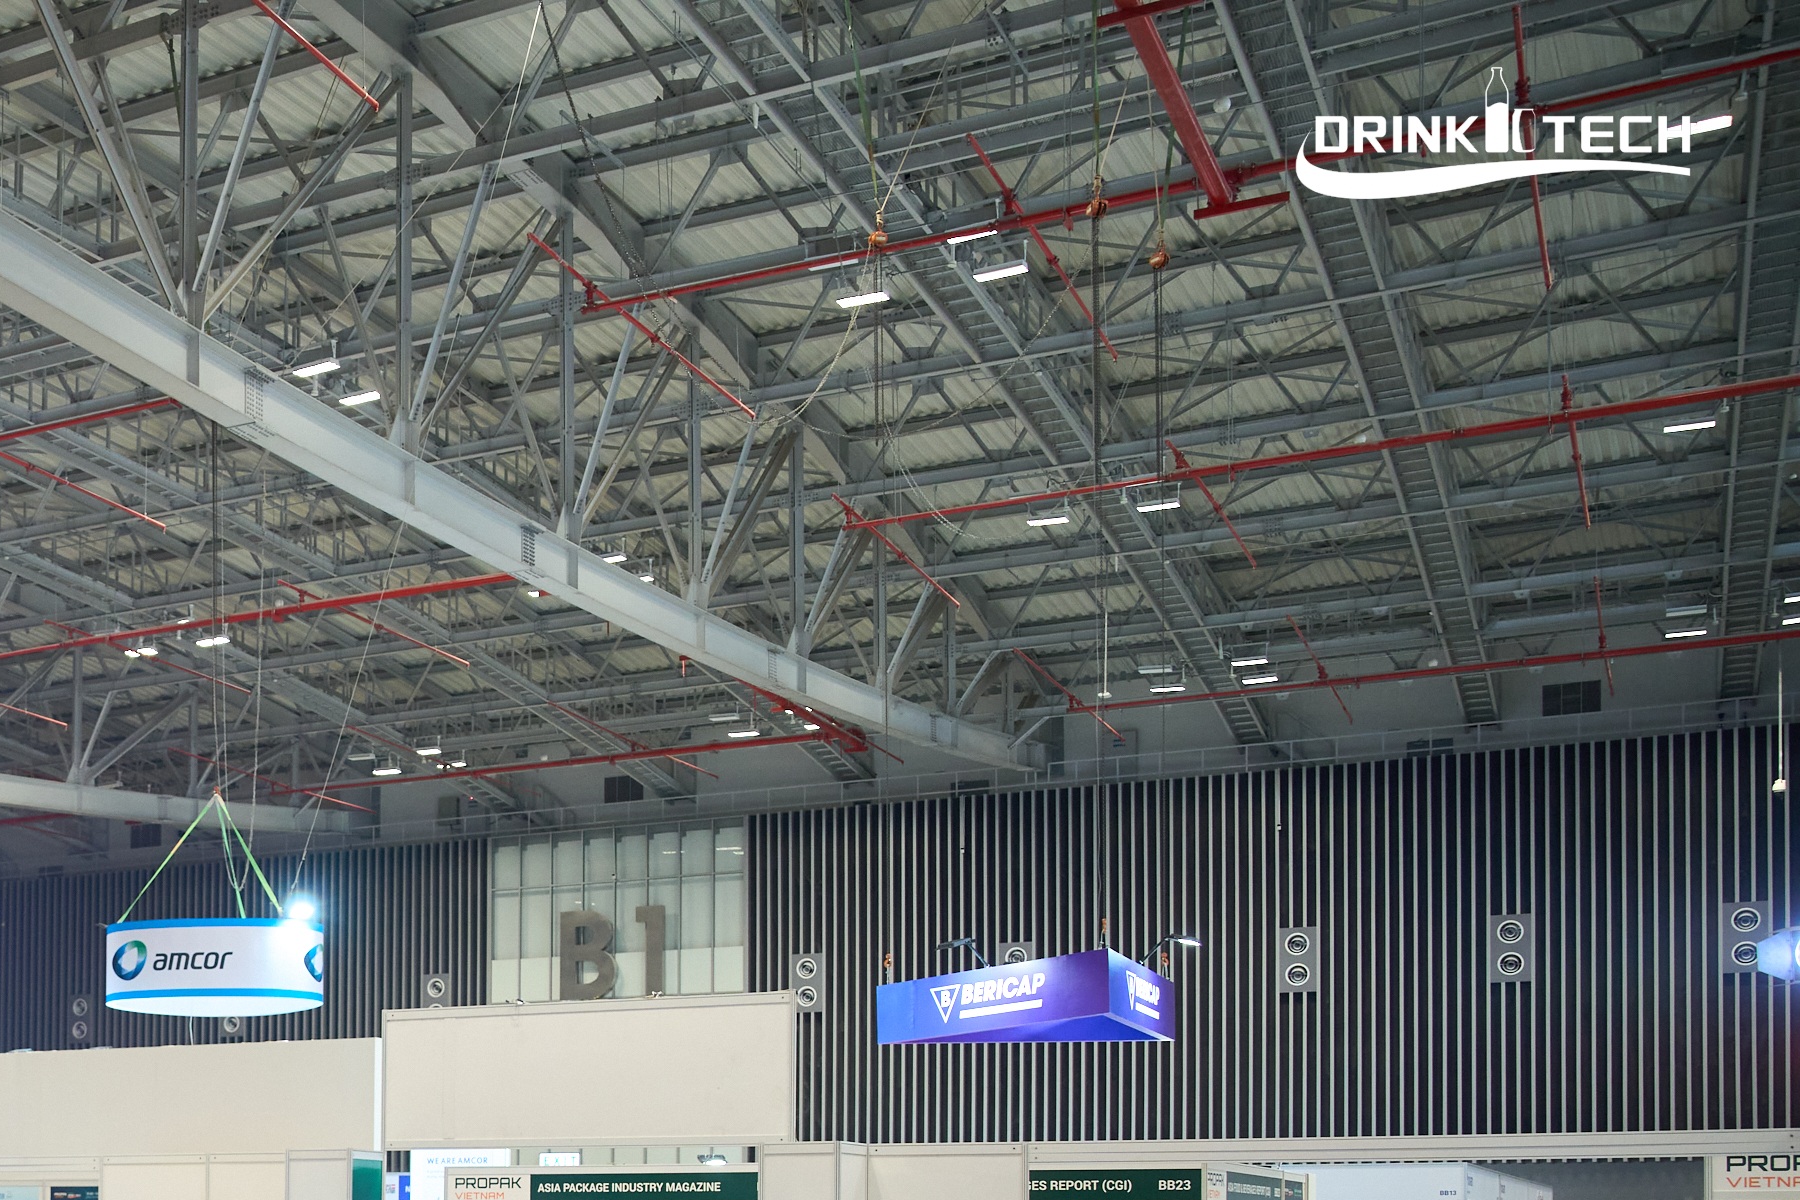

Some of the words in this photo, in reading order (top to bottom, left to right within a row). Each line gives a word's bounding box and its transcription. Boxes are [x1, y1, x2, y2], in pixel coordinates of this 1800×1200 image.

[560, 905, 666, 1000] B1
[153, 951, 233, 971] amcor
[960, 972, 1046, 1006] BERICAP
[426, 1157, 439, 1165] WE
[441, 1157, 456, 1165] ARE
[458, 1156, 488, 1165] AMCOR
[544, 1155, 576, 1166] EXIT
[454, 1176, 522, 1189] PROPAK
[537, 1183, 561, 1193] ASIA
[563, 1182, 609, 1193] PACKAGE
[611, 1182, 663, 1192] INDUSTRY
[665, 1182, 721, 1192] MAGAZINE
[1050, 1180, 1099, 1190] REPORT
[1102, 1179, 1132, 1193] (CGI)
[1158, 1179, 1191, 1191] BB23
[454, 1191, 505, 1200] VIETNAM
